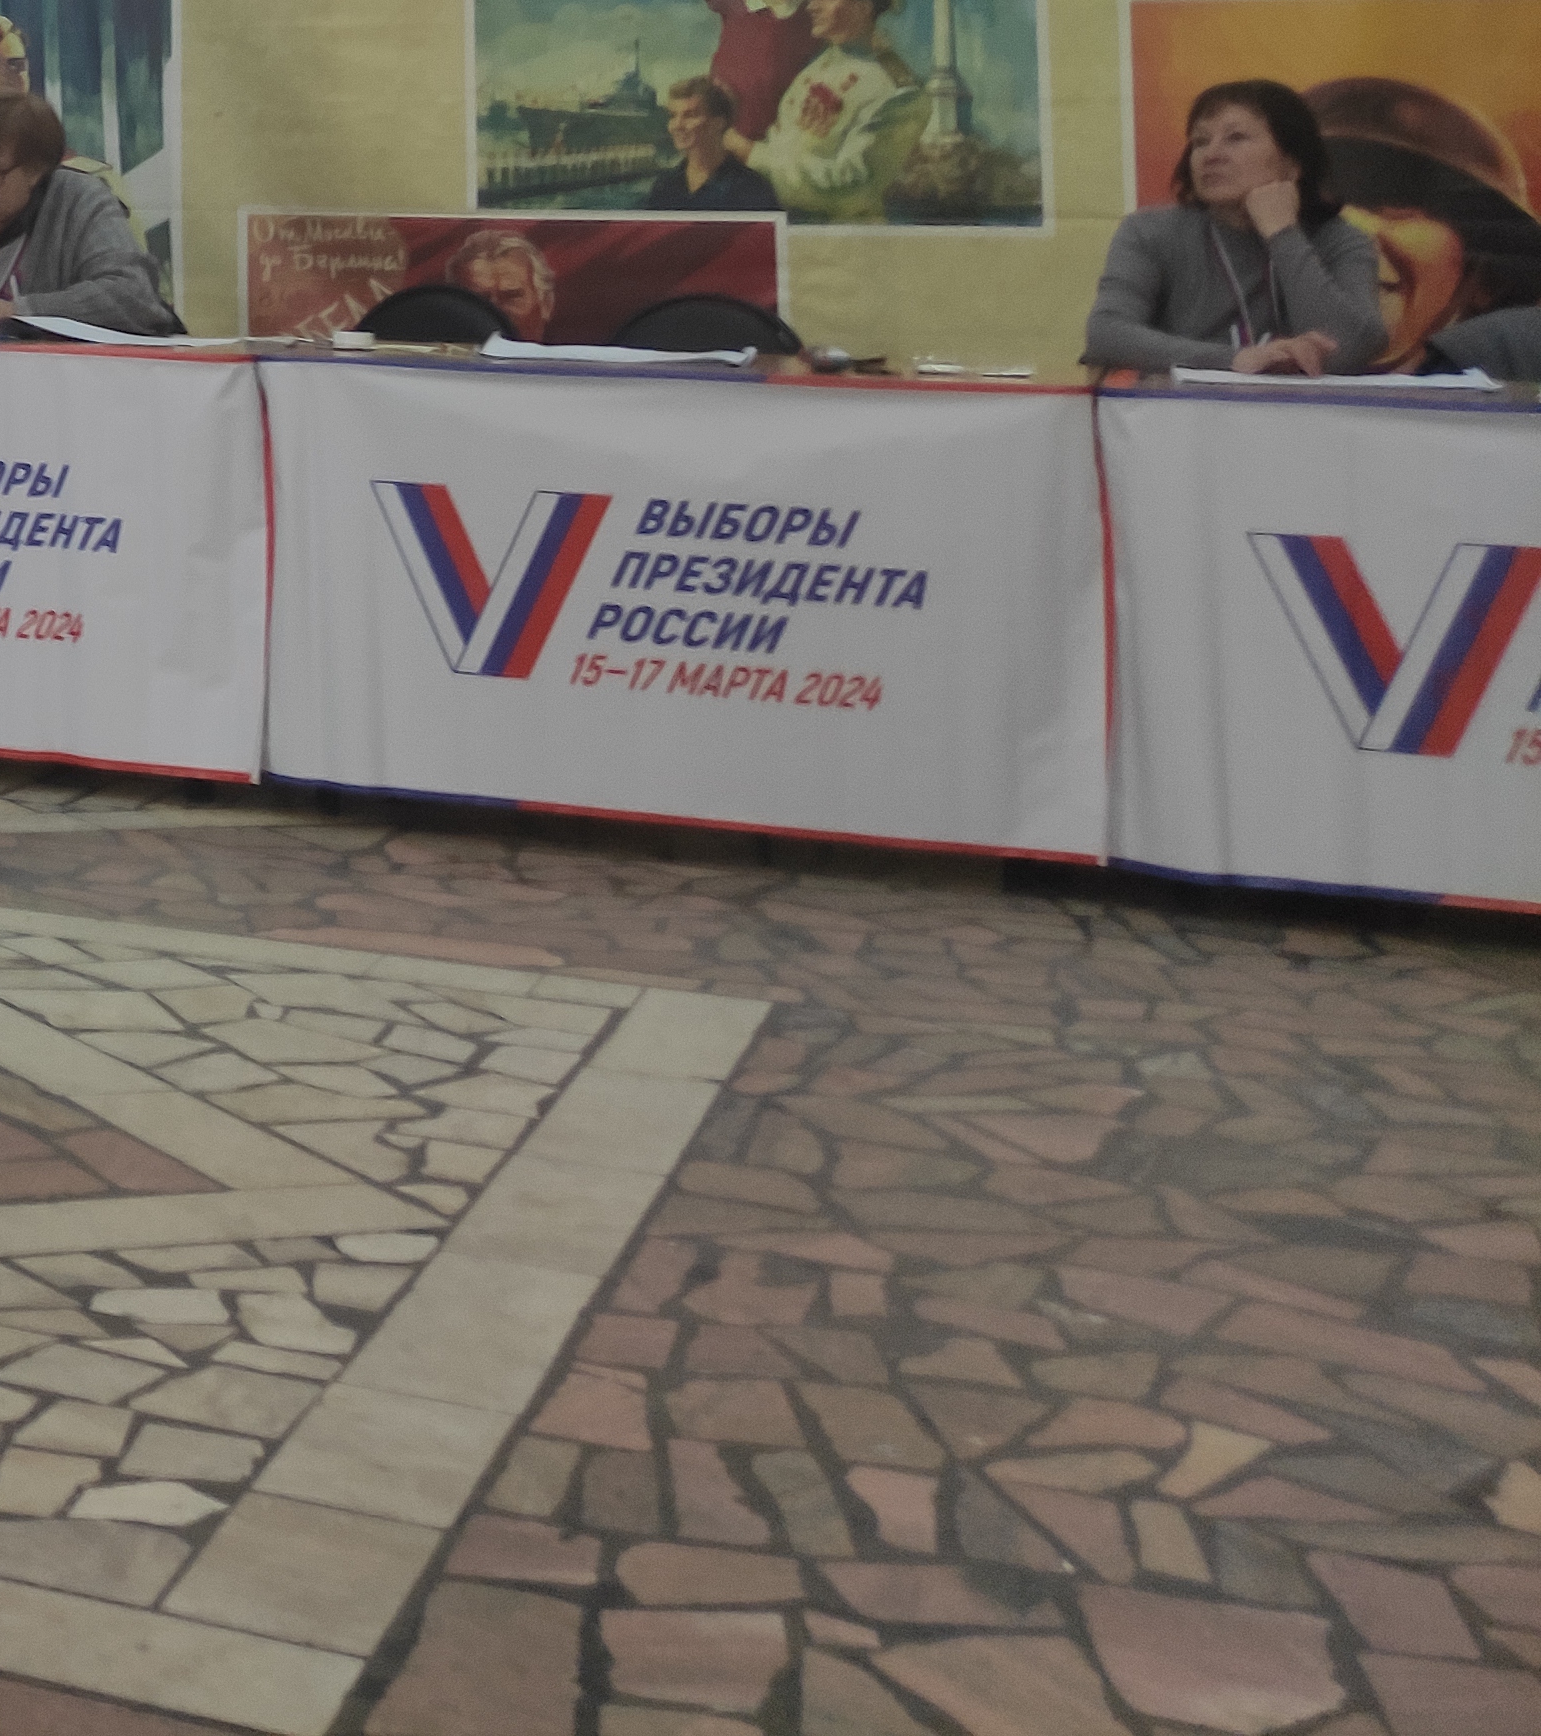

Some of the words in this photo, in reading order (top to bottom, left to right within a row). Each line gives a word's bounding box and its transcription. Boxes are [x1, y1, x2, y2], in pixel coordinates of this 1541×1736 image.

[635, 498, 862, 549] ВЫБОРЫ
[611, 550, 929, 611] ПРЕЗИДЕНТА
[15, 609, 85, 643] 2024
[586, 602, 789, 654] РОССИИ
[667, 661, 789, 703] МАРТА
[794, 671, 884, 711] 2024
